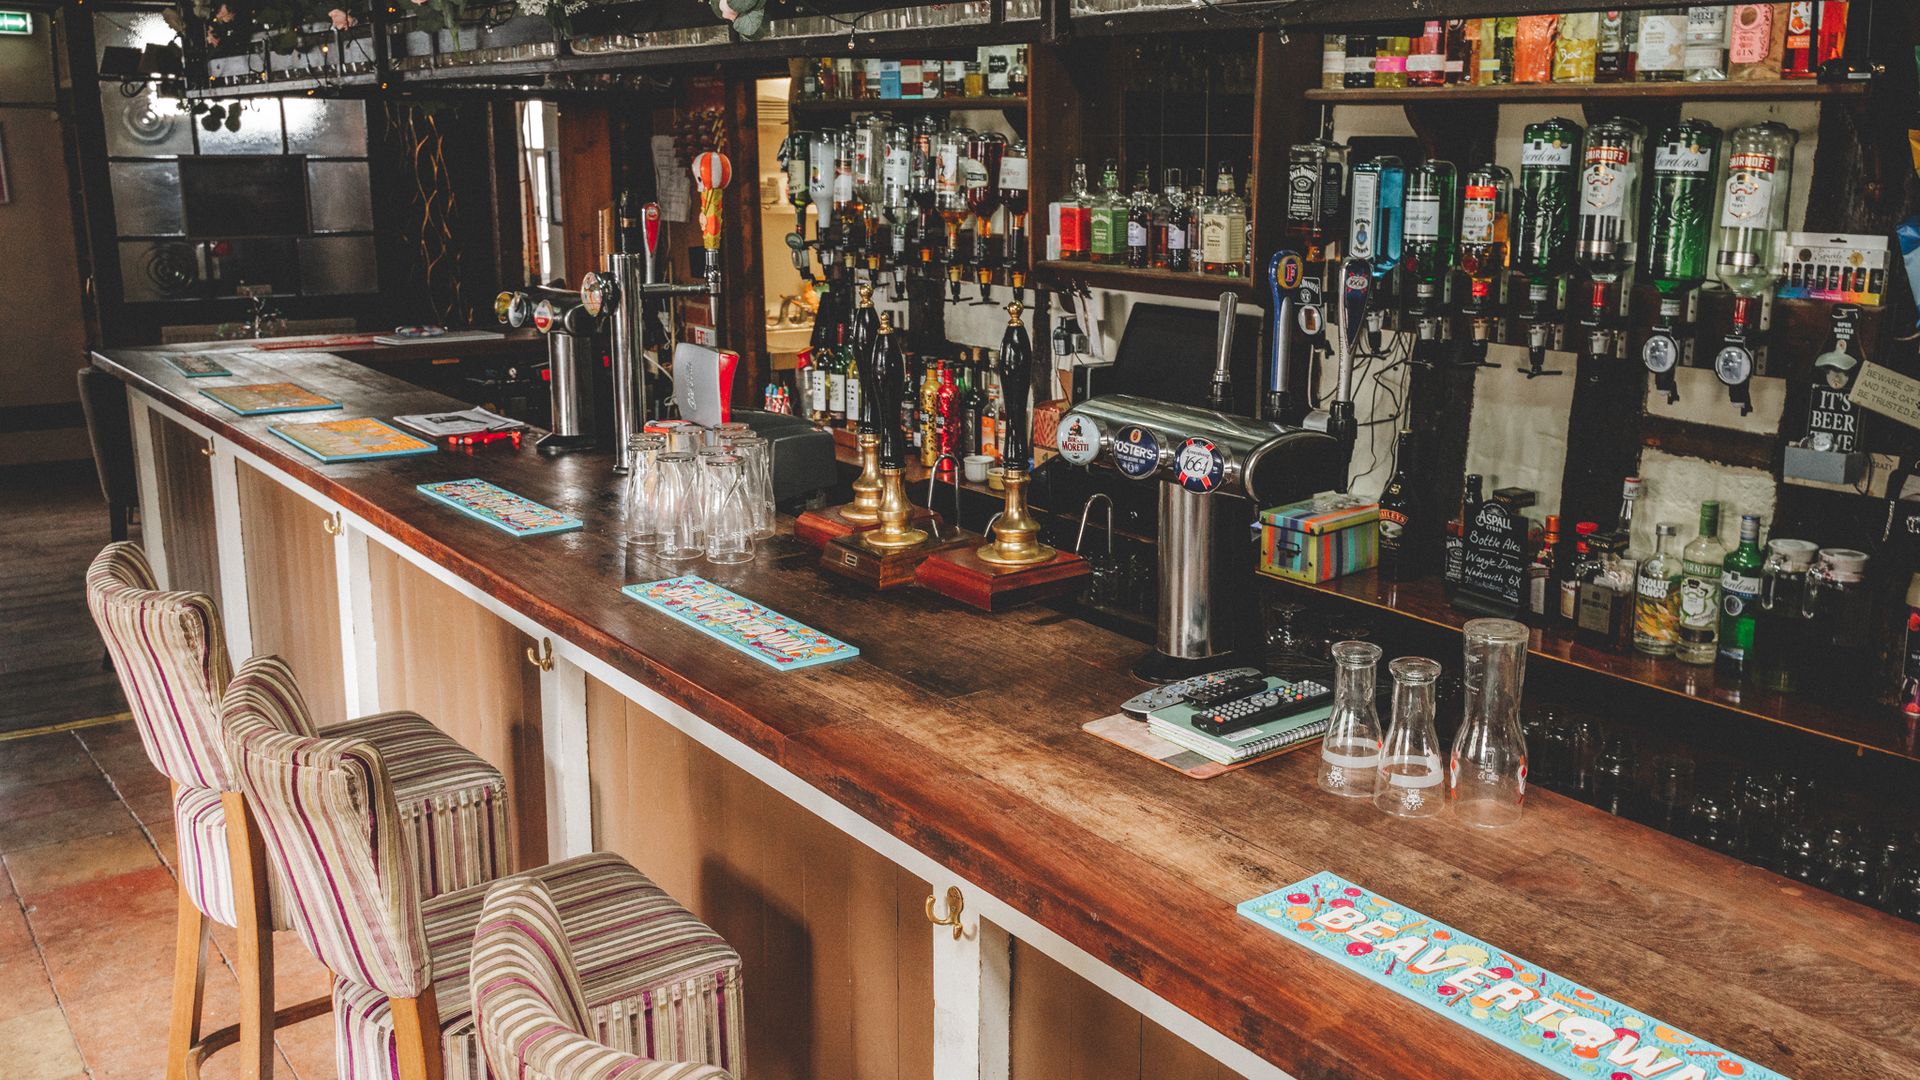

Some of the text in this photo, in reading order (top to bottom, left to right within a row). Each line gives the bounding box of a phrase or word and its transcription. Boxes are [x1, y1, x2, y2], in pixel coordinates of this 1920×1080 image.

[1736, 49, 1754, 57] GIN
[1866, 369, 1903, 390] BEWARE
[1820, 390, 1851, 411] IT'S
[1857, 388, 1870, 400] BE
[1871, 394, 1911, 416] TRUSTED
[1861, 380, 1916, 405] AND THE CAT
[1812, 410, 1855, 433] BEER
[1062, 441, 1089, 452] MORETTI
[1114, 440, 1154, 459] FOSTER'S
[1183, 455, 1209, 474] 1664
[1380, 510, 1405, 523] AILEYS
[1476, 510, 1512, 530] ASPALL
[1470, 530, 1501, 548] Bottle
[1503, 538, 1520, 552] Ales
[1498, 558, 1523, 573] Dance
[1508, 575, 1520, 588] 6X
